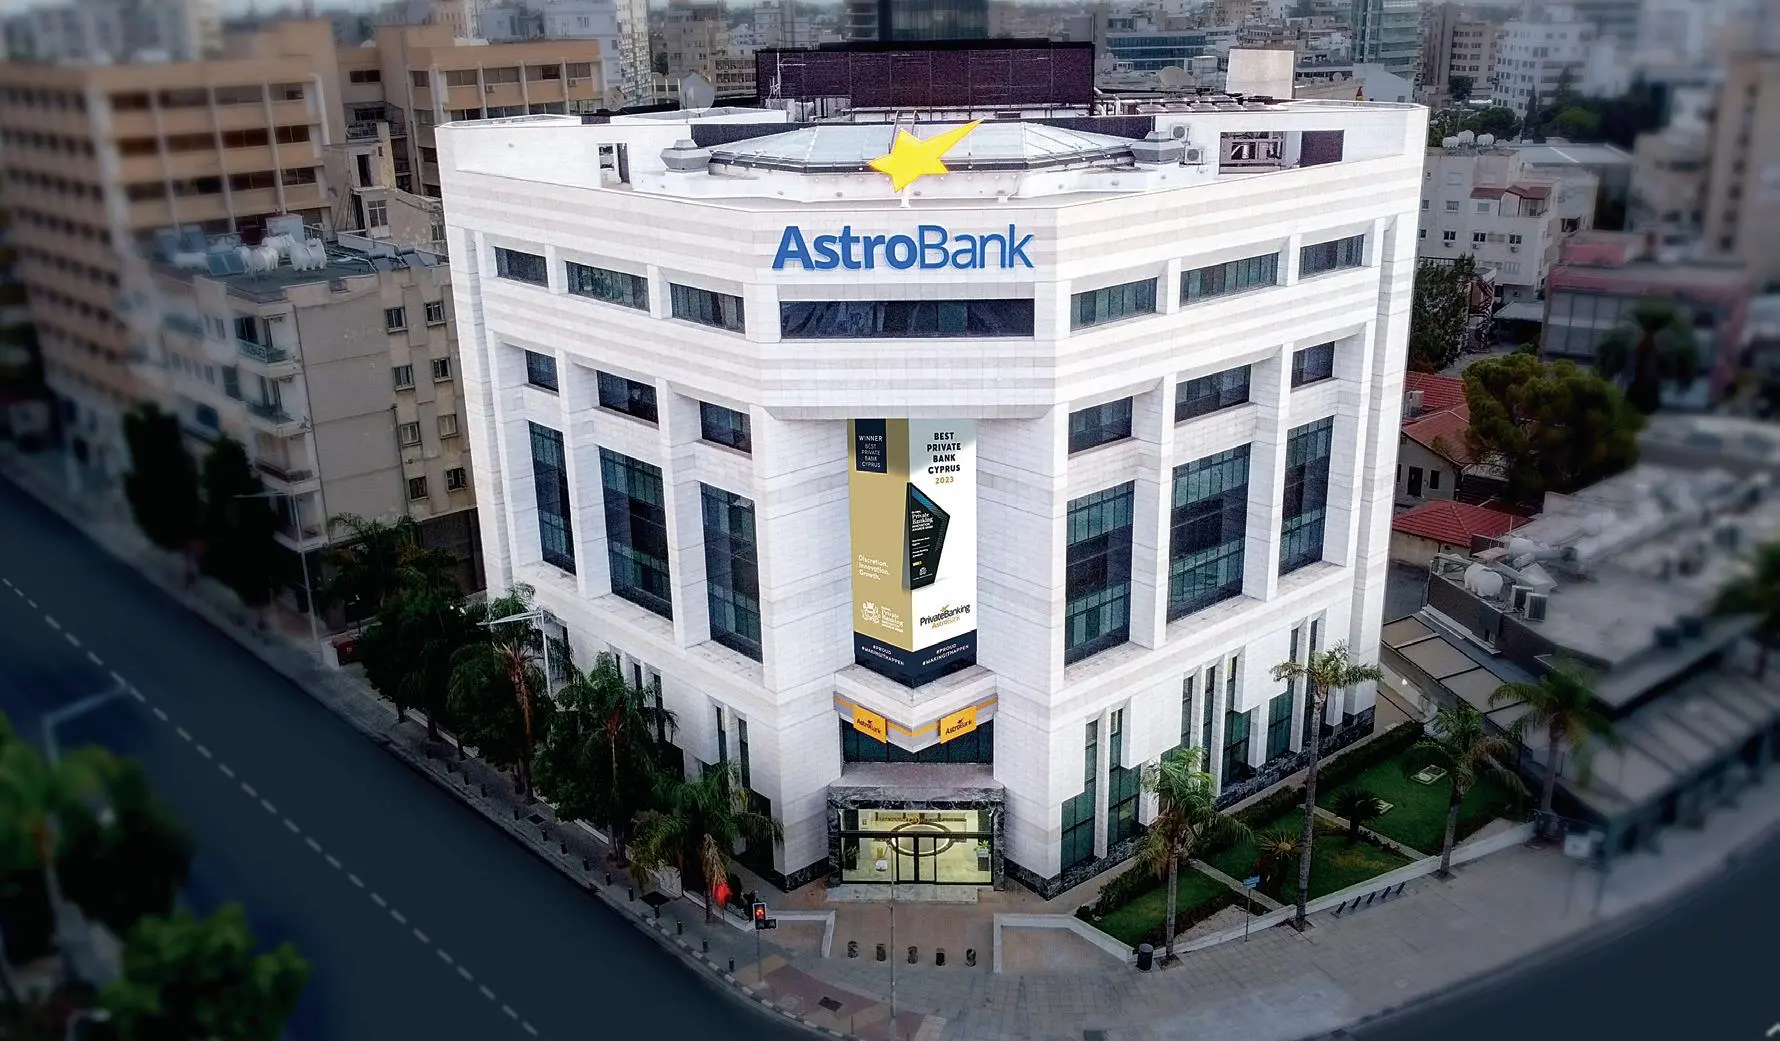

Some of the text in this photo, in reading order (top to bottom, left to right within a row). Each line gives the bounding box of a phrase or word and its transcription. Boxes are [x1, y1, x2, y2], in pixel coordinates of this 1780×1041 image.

[772, 224, 1034, 270] AstroBank
[934, 432, 955, 441] BEST
[926, 443, 962, 452] PRIVATE
[932, 454, 956, 463] BANK
[928, 464, 961, 474] CYPRUS
[936, 476, 954, 485] 2023
[920, 604, 970, 626] PrivateBanking
[857, 718, 882, 734] AstroBank
[945, 719, 973, 735] AstroBank
